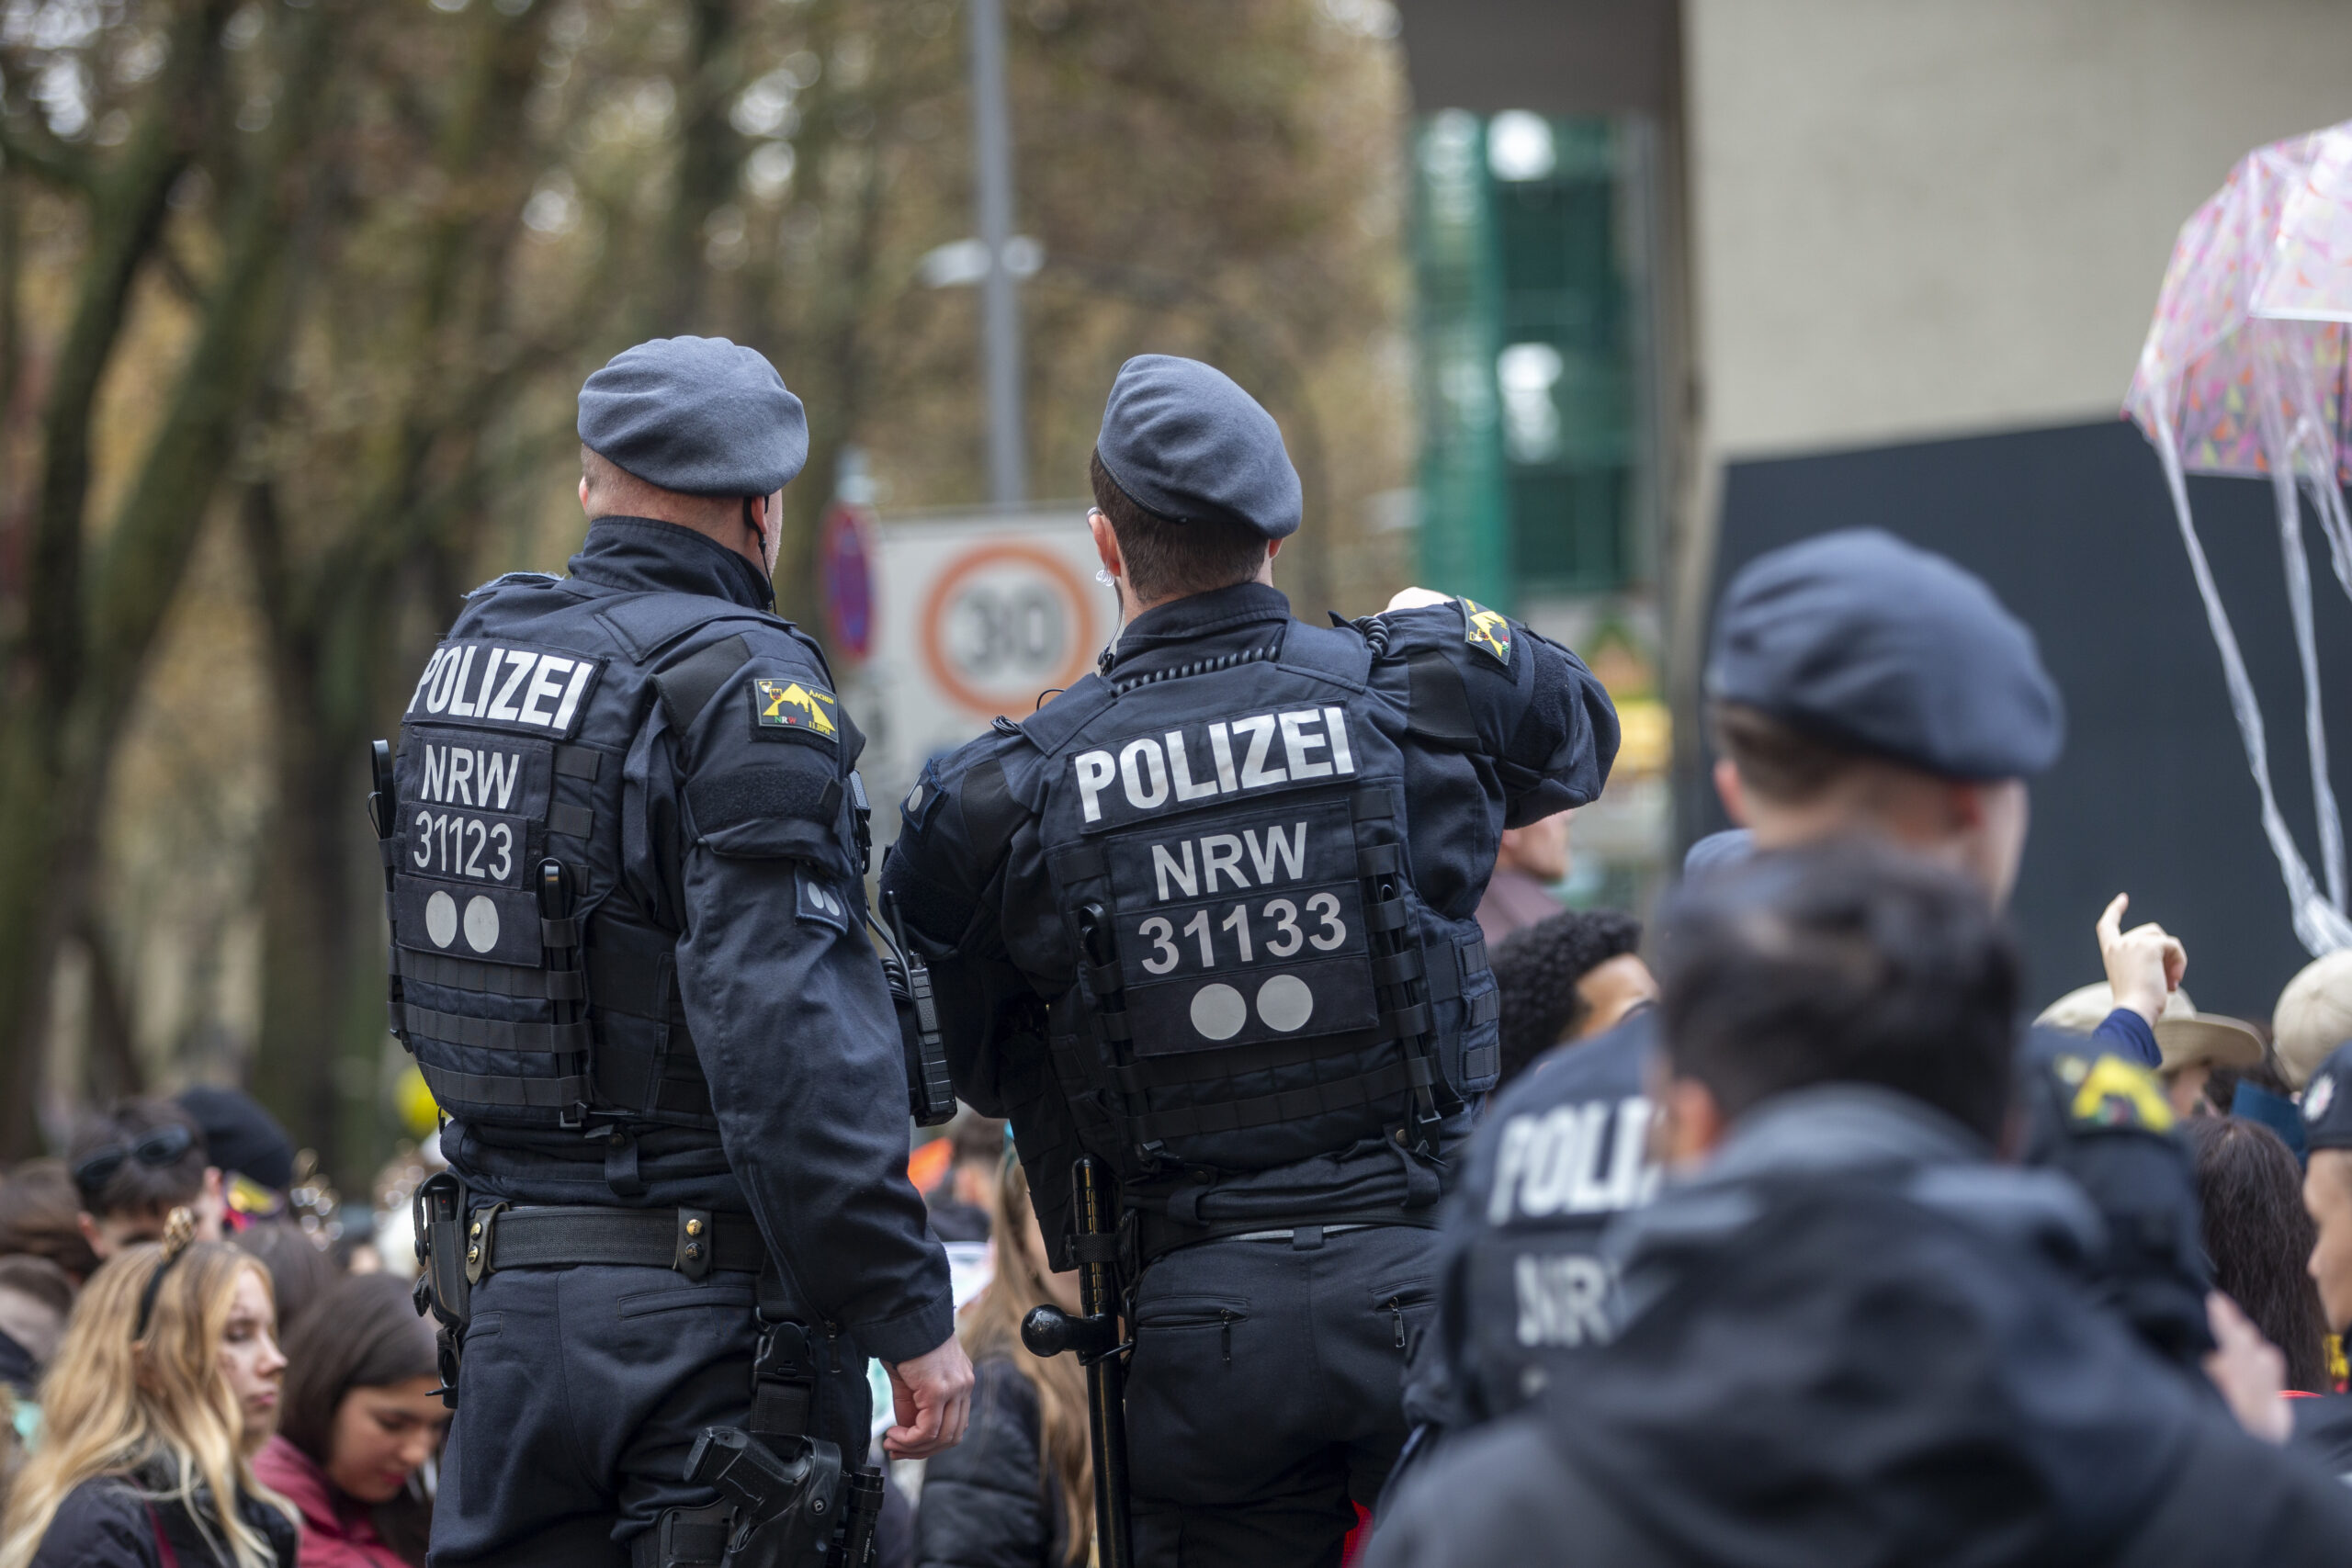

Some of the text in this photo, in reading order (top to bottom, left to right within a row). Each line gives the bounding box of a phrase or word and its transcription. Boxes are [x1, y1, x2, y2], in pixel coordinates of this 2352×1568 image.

[961, 582, 1066, 676] 30
[406, 645, 594, 731] POLIZEI
[774, 716, 797, 726] NRW
[419, 744, 521, 810] NRW
[1074, 706, 1355, 824] POLIZEI
[413, 810, 513, 881] 31123
[1151, 821, 1307, 901] NRW
[1138, 892, 1348, 975] 31133
[1487, 1097, 1663, 1226] POLI
[1513, 1252, 1617, 1348] NR
